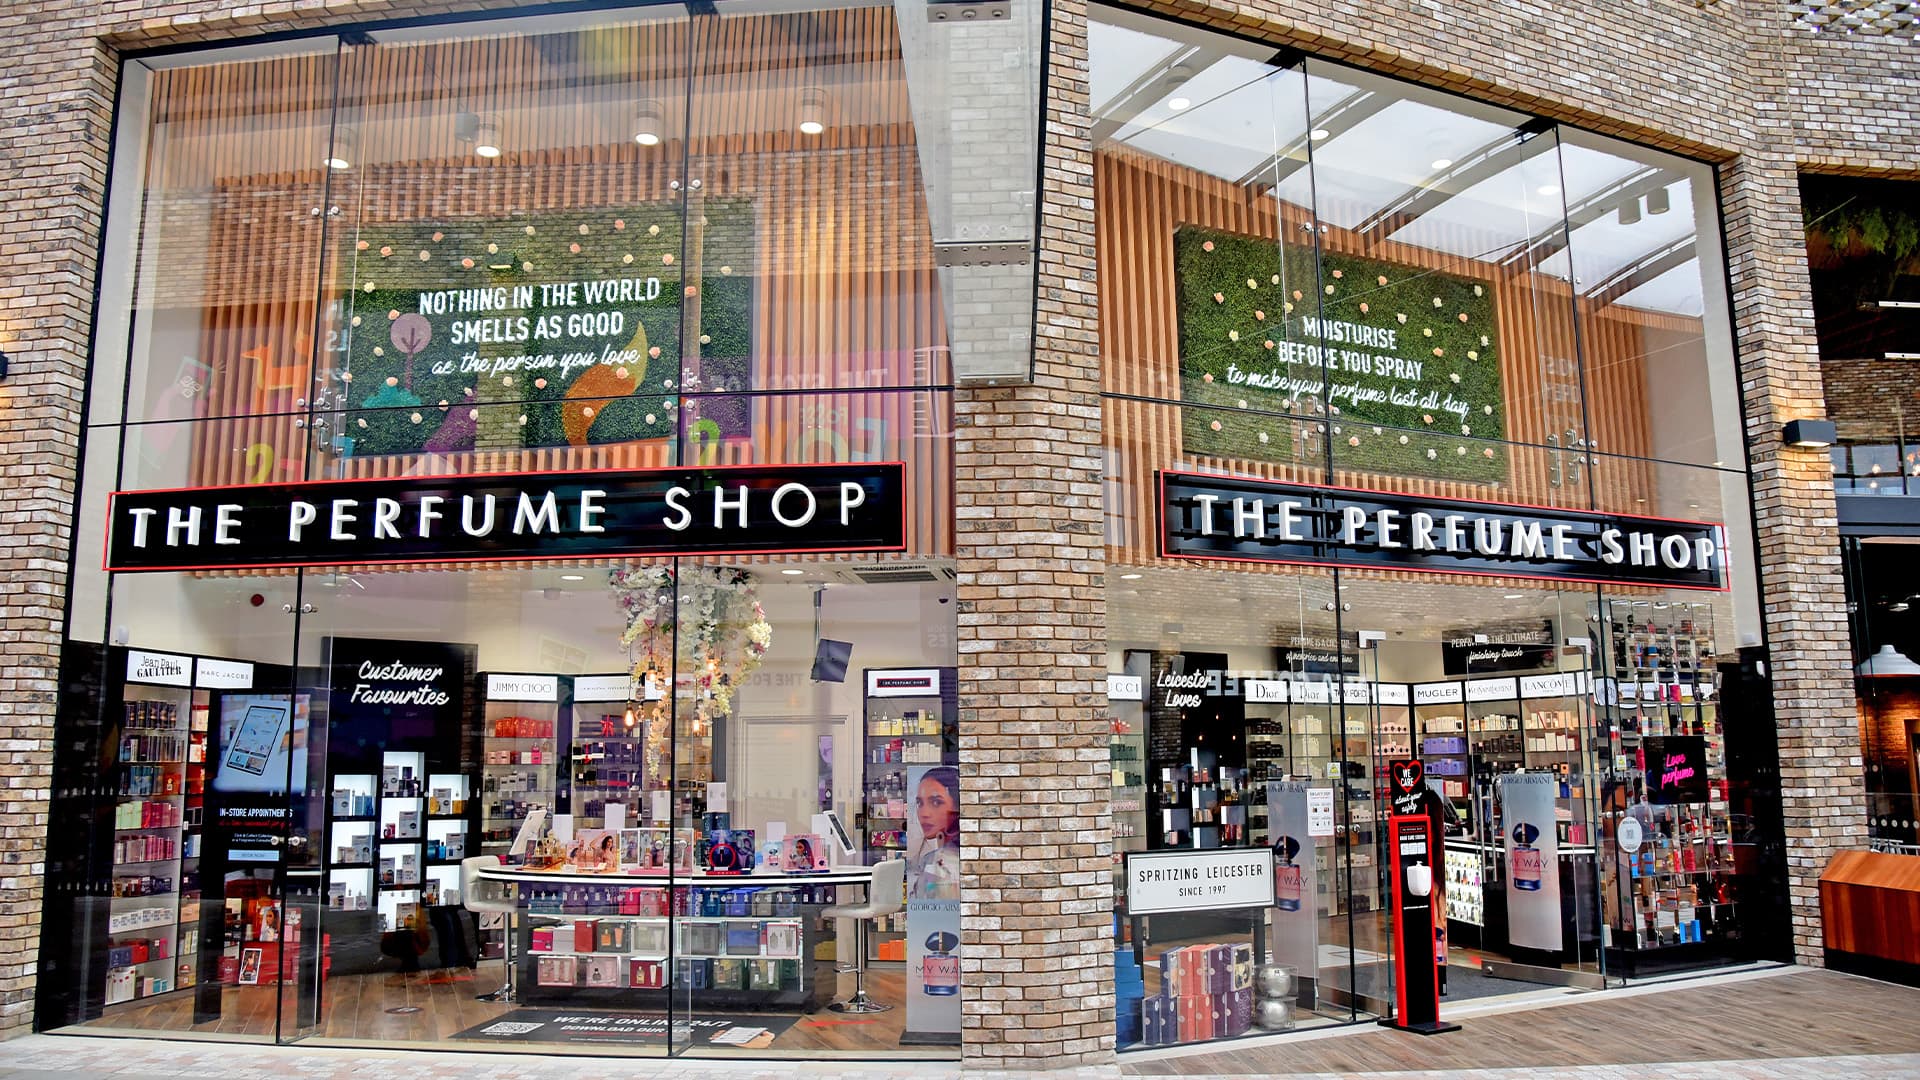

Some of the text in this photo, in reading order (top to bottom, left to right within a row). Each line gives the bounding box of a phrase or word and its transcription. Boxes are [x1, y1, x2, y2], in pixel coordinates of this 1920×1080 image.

[419, 277, 660, 315] NOTHING IN THE WORLD
[451, 311, 624, 345] SMELLS AS GOOD
[1302, 316, 1397, 350] MOISTURISE
[460, 351, 489, 373] the
[490, 352, 557, 378] person
[559, 350, 597, 379] you
[600, 343, 640, 365] love
[1279, 341, 1422, 381] BEFORE YOU SPRAY
[1226, 363, 1470, 423] to make your perfume last all day
[129, 482, 866, 548] THE PERFUME SHOP
[1193, 494, 1715, 570] THE PERFUME SHOP
[137, 666, 182, 678] GAULTIER
[358, 659, 443, 682] Customer
[1157, 668, 1212, 688] Leicester
[350, 683, 450, 706] Favourites
[492, 682, 552, 693] JIMMY CHOO
[1255, 683, 1278, 699] Dior
[1417, 688, 1458, 698] MUGLER
[1165, 689, 1202, 708] Loves
[1666, 753, 1686, 768] Love
[1402, 768, 1412, 778] WE
[1661, 765, 1694, 790] perfume
[1400, 777, 1415, 787] CARE
[219, 807, 247, 817] IN-STORE
[1523, 859, 1549, 869] WAY
[1139, 864, 1263, 883] SPRITZING LEICESTER
[1284, 876, 1308, 887] WAY
[1179, 885, 1227, 896] SINCE 1997
[910, 902, 960, 912] GIORGIO ARM
[916, 965, 961, 974] MY WA
[553, 1016, 615, 1024] WE'RE
[618, 1017, 689, 1026] ONLINE
